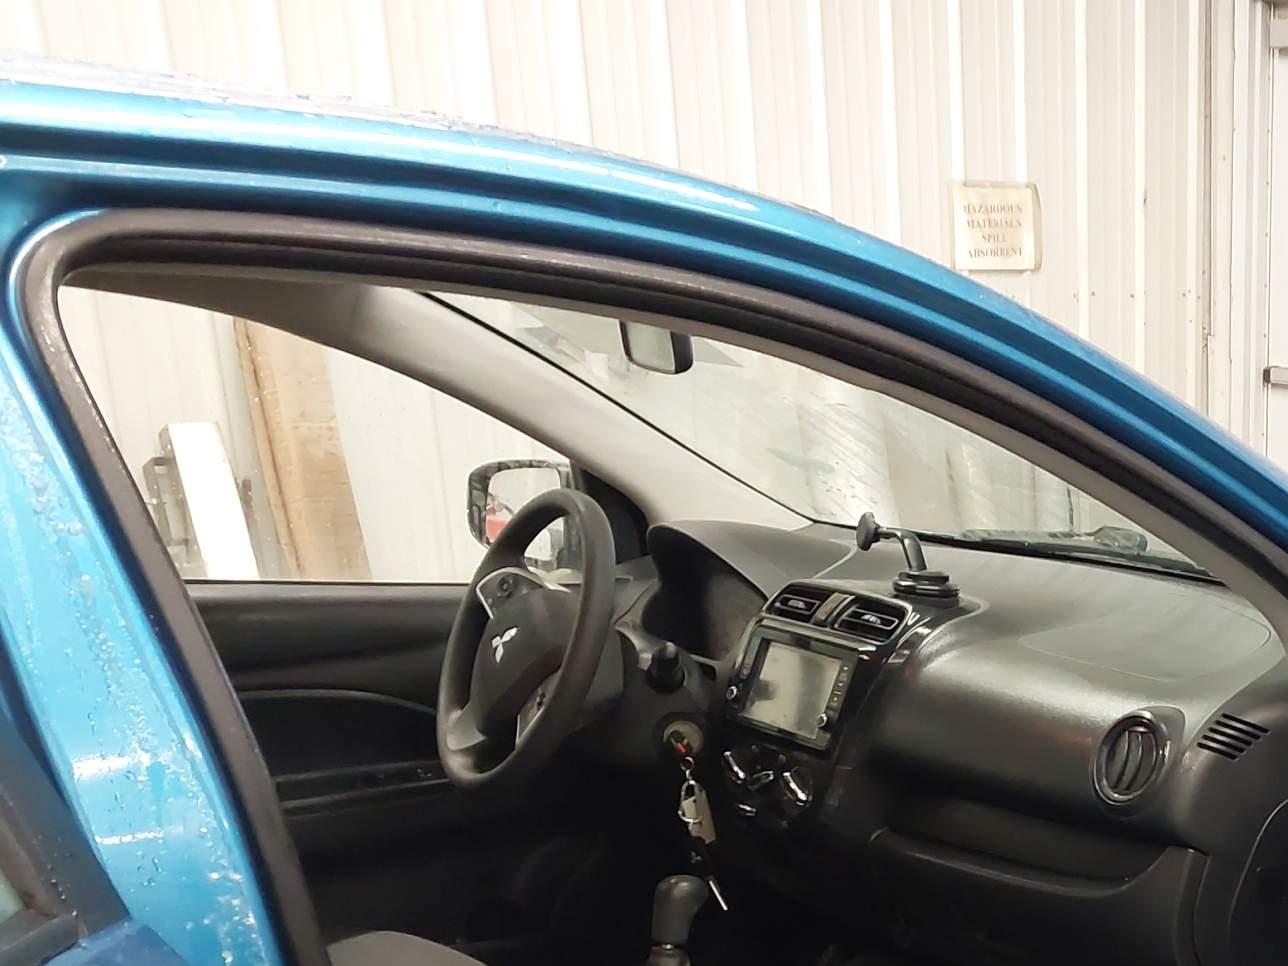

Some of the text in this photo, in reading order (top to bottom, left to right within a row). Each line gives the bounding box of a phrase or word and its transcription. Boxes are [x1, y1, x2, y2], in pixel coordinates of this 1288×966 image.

[963, 203, 1023, 214] HAZARDOUS
[966, 218, 1022, 229] MATERIALS
[981, 233, 1008, 243] SPILL
[968, 247, 1022, 259] ABSORBENT
